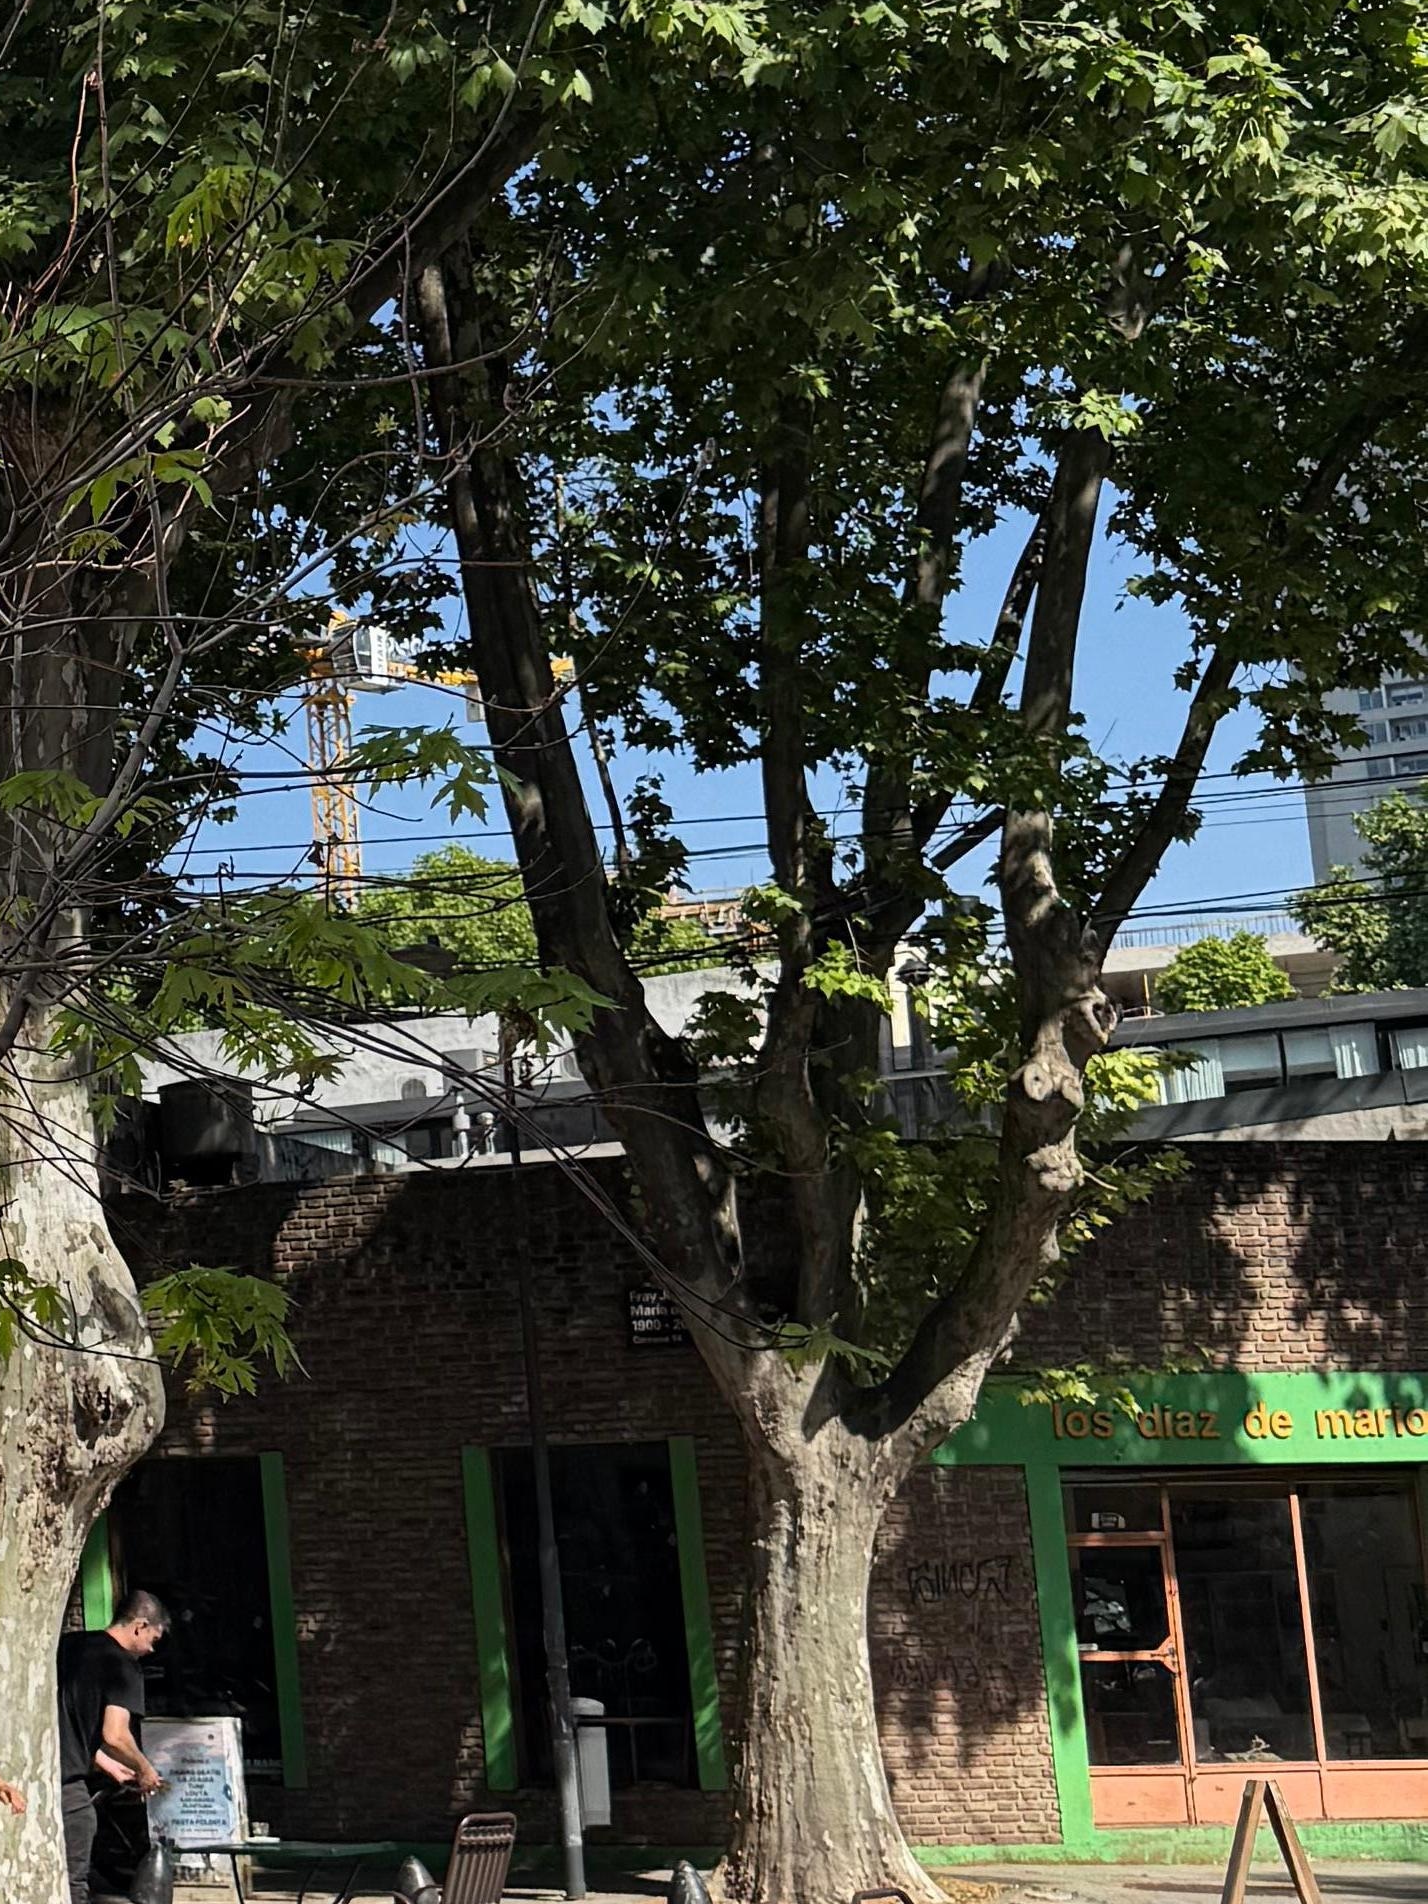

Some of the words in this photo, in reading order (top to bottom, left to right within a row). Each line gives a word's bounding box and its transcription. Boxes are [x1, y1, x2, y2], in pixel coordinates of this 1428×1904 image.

[630, 1290, 657, 1304] Fray
[632, 1319, 661, 1331] 1900
[1052, 1402, 1115, 1440] los
[1244, 1400, 1293, 1439] de
[1315, 1402, 1428, 1439] mario
